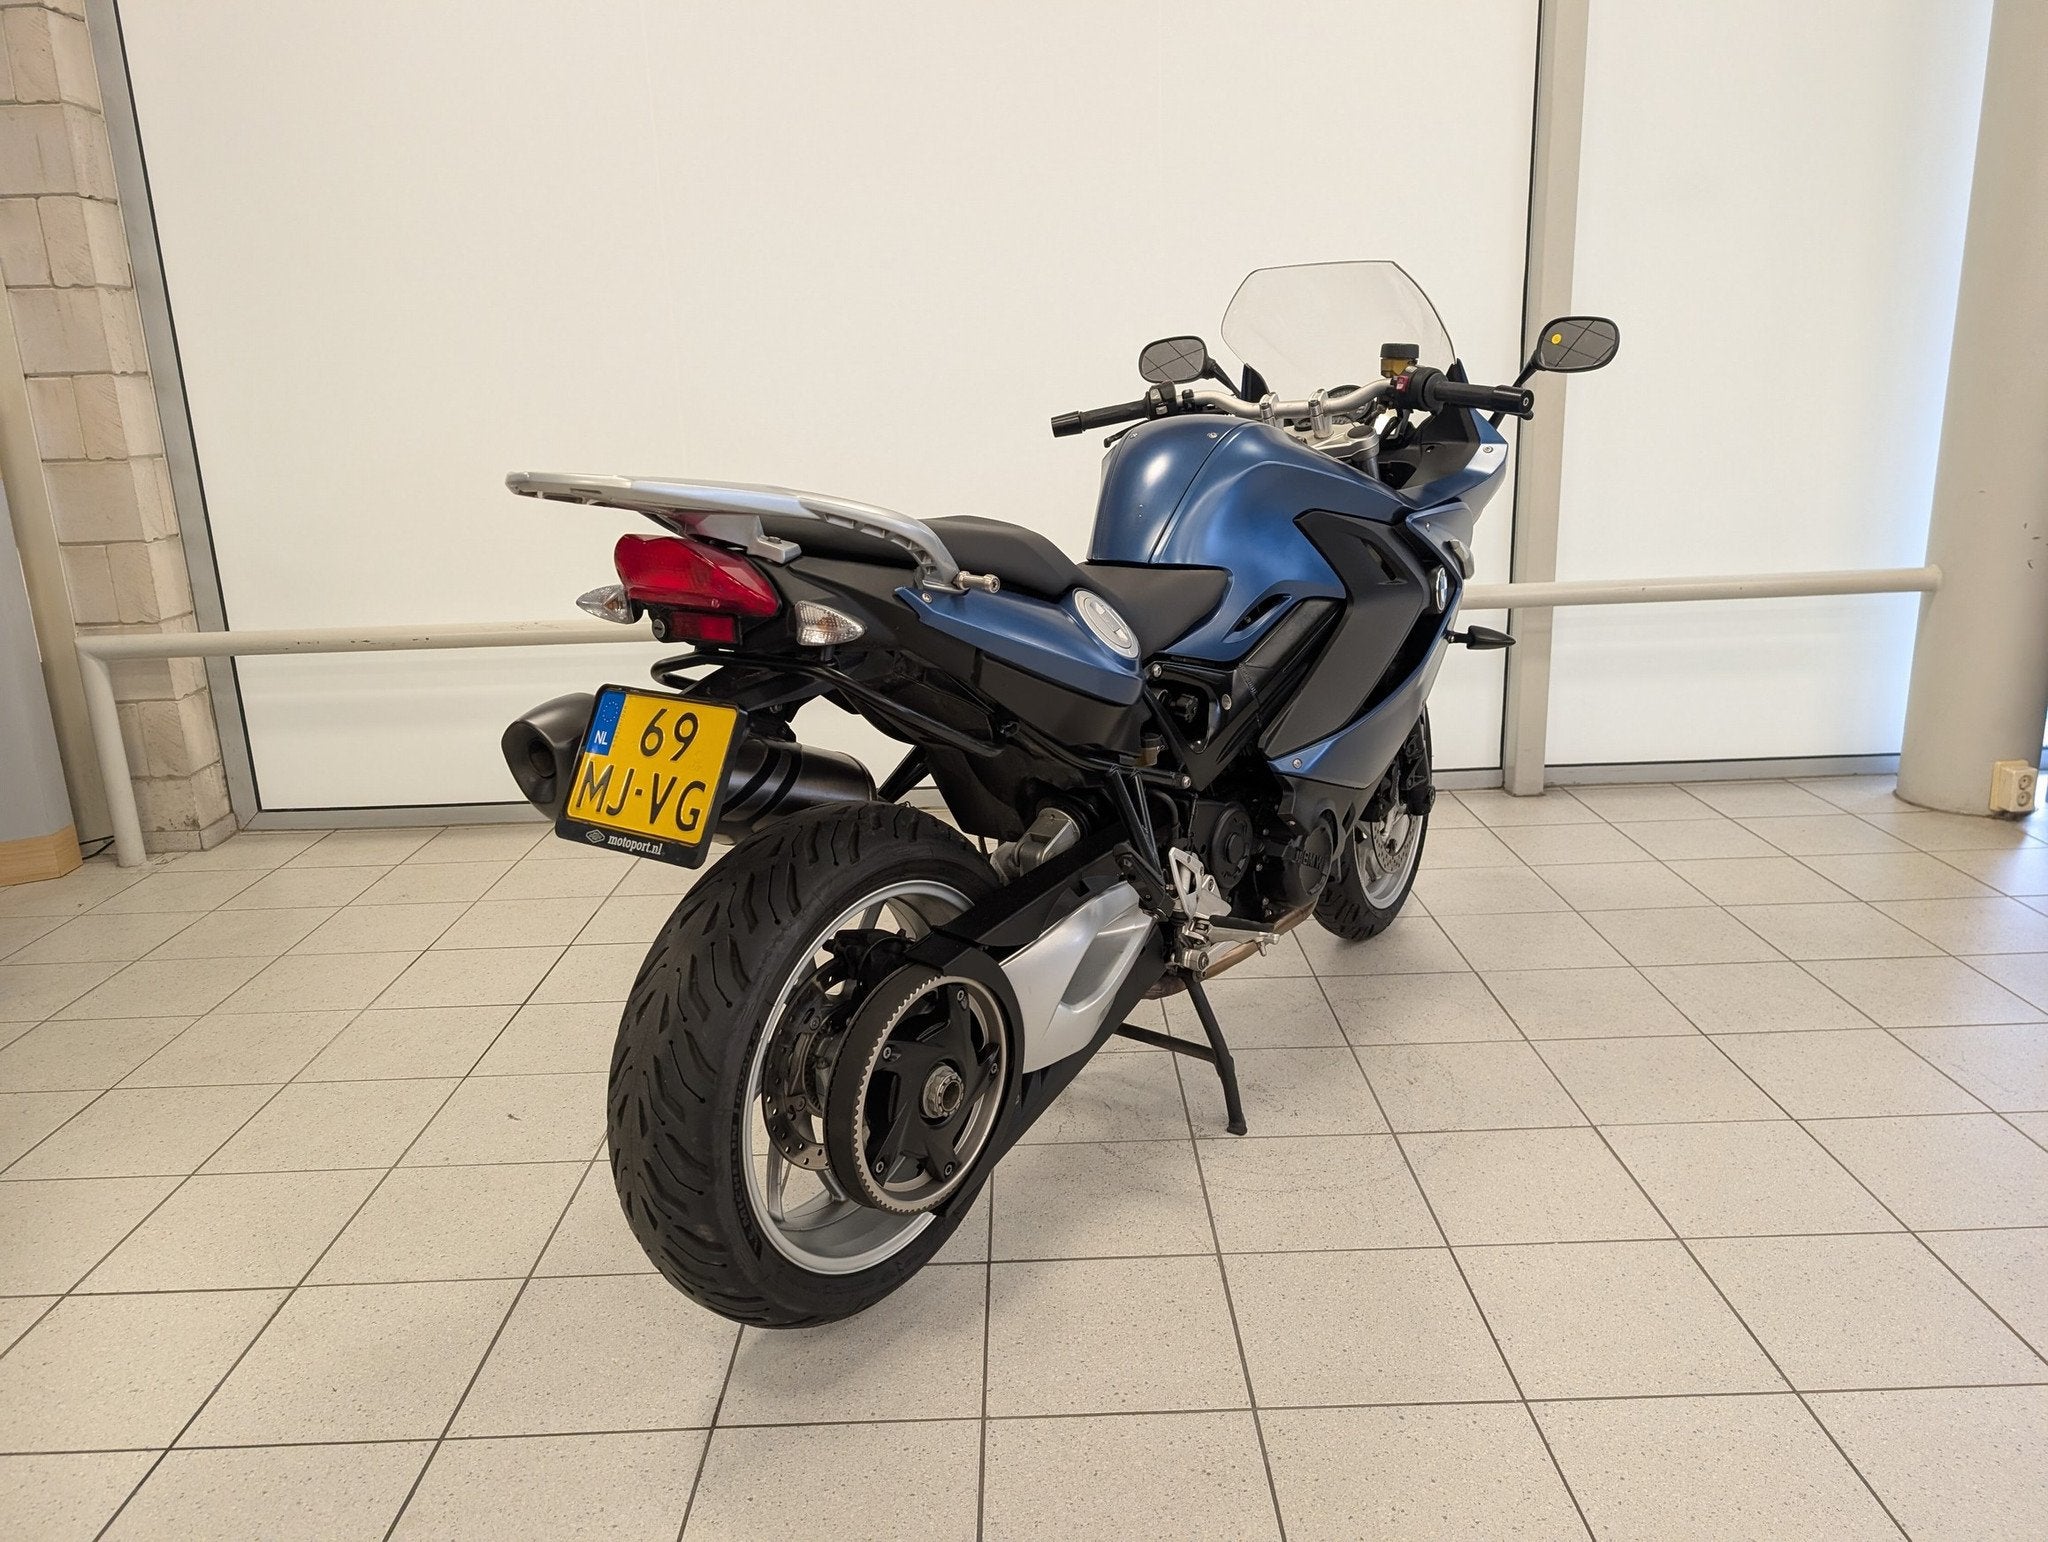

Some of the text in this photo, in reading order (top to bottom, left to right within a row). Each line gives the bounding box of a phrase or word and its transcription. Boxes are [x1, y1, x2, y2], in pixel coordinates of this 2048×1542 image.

[593, 730, 608, 745] NL
[639, 708, 699, 762] 69
[607, 835, 664, 855] motoport.nl
